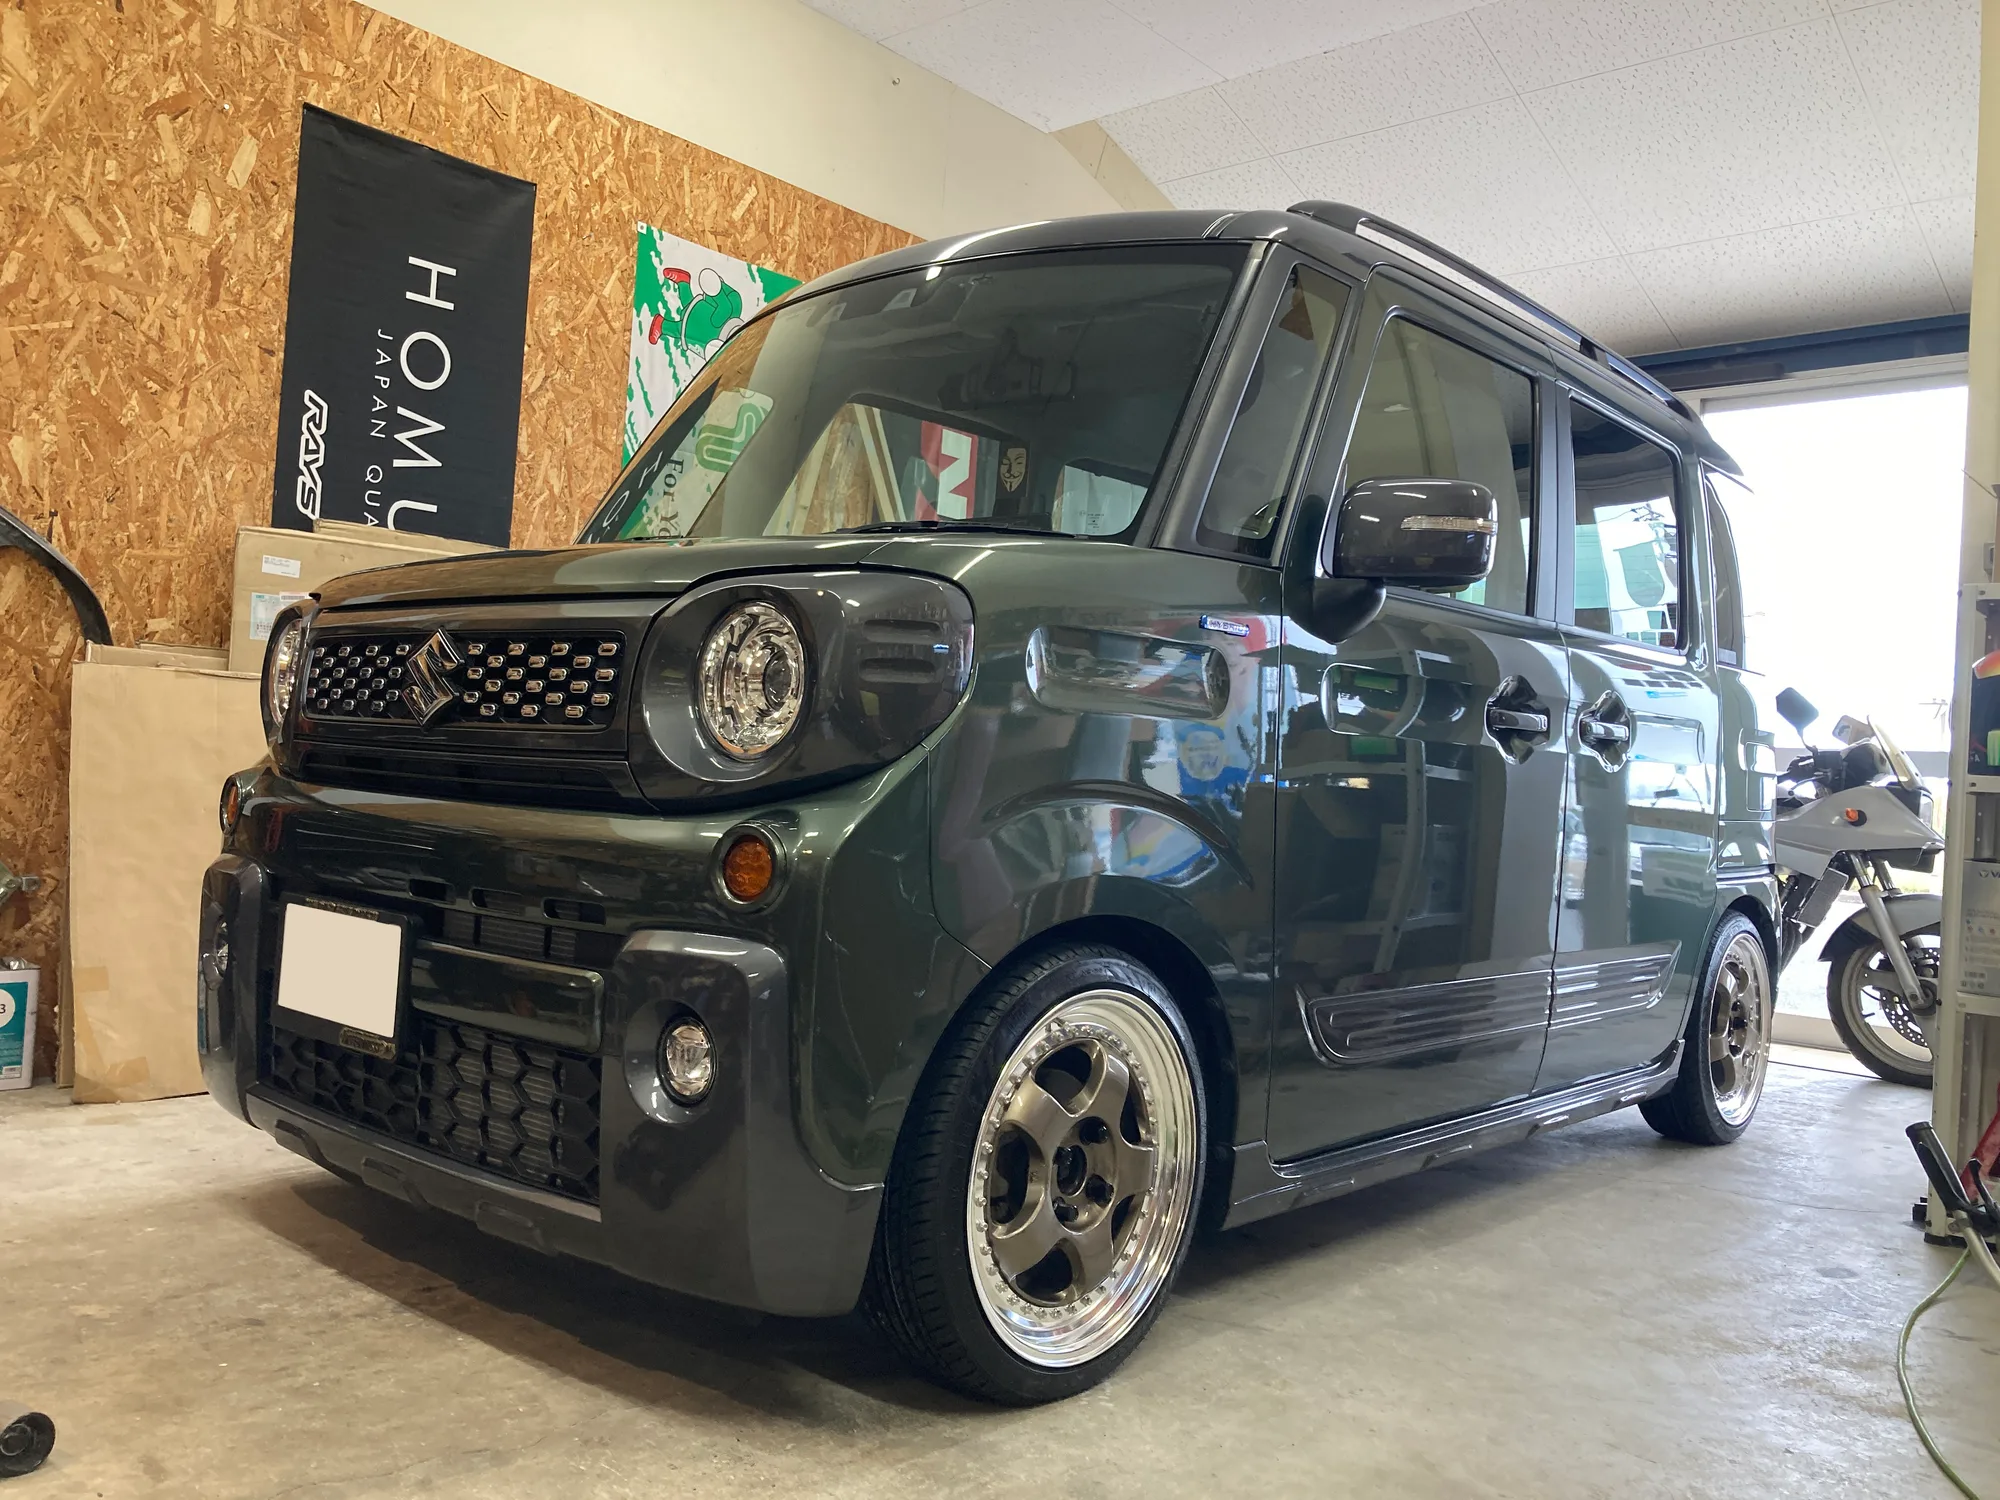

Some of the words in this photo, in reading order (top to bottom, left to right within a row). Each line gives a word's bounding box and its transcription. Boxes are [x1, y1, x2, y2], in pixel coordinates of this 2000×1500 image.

[370, 328, 394, 438] JAPAN
[296, 389, 329, 520] RAYS
[363, 464, 383, 527] QUA
[663, 458, 684, 503] For
